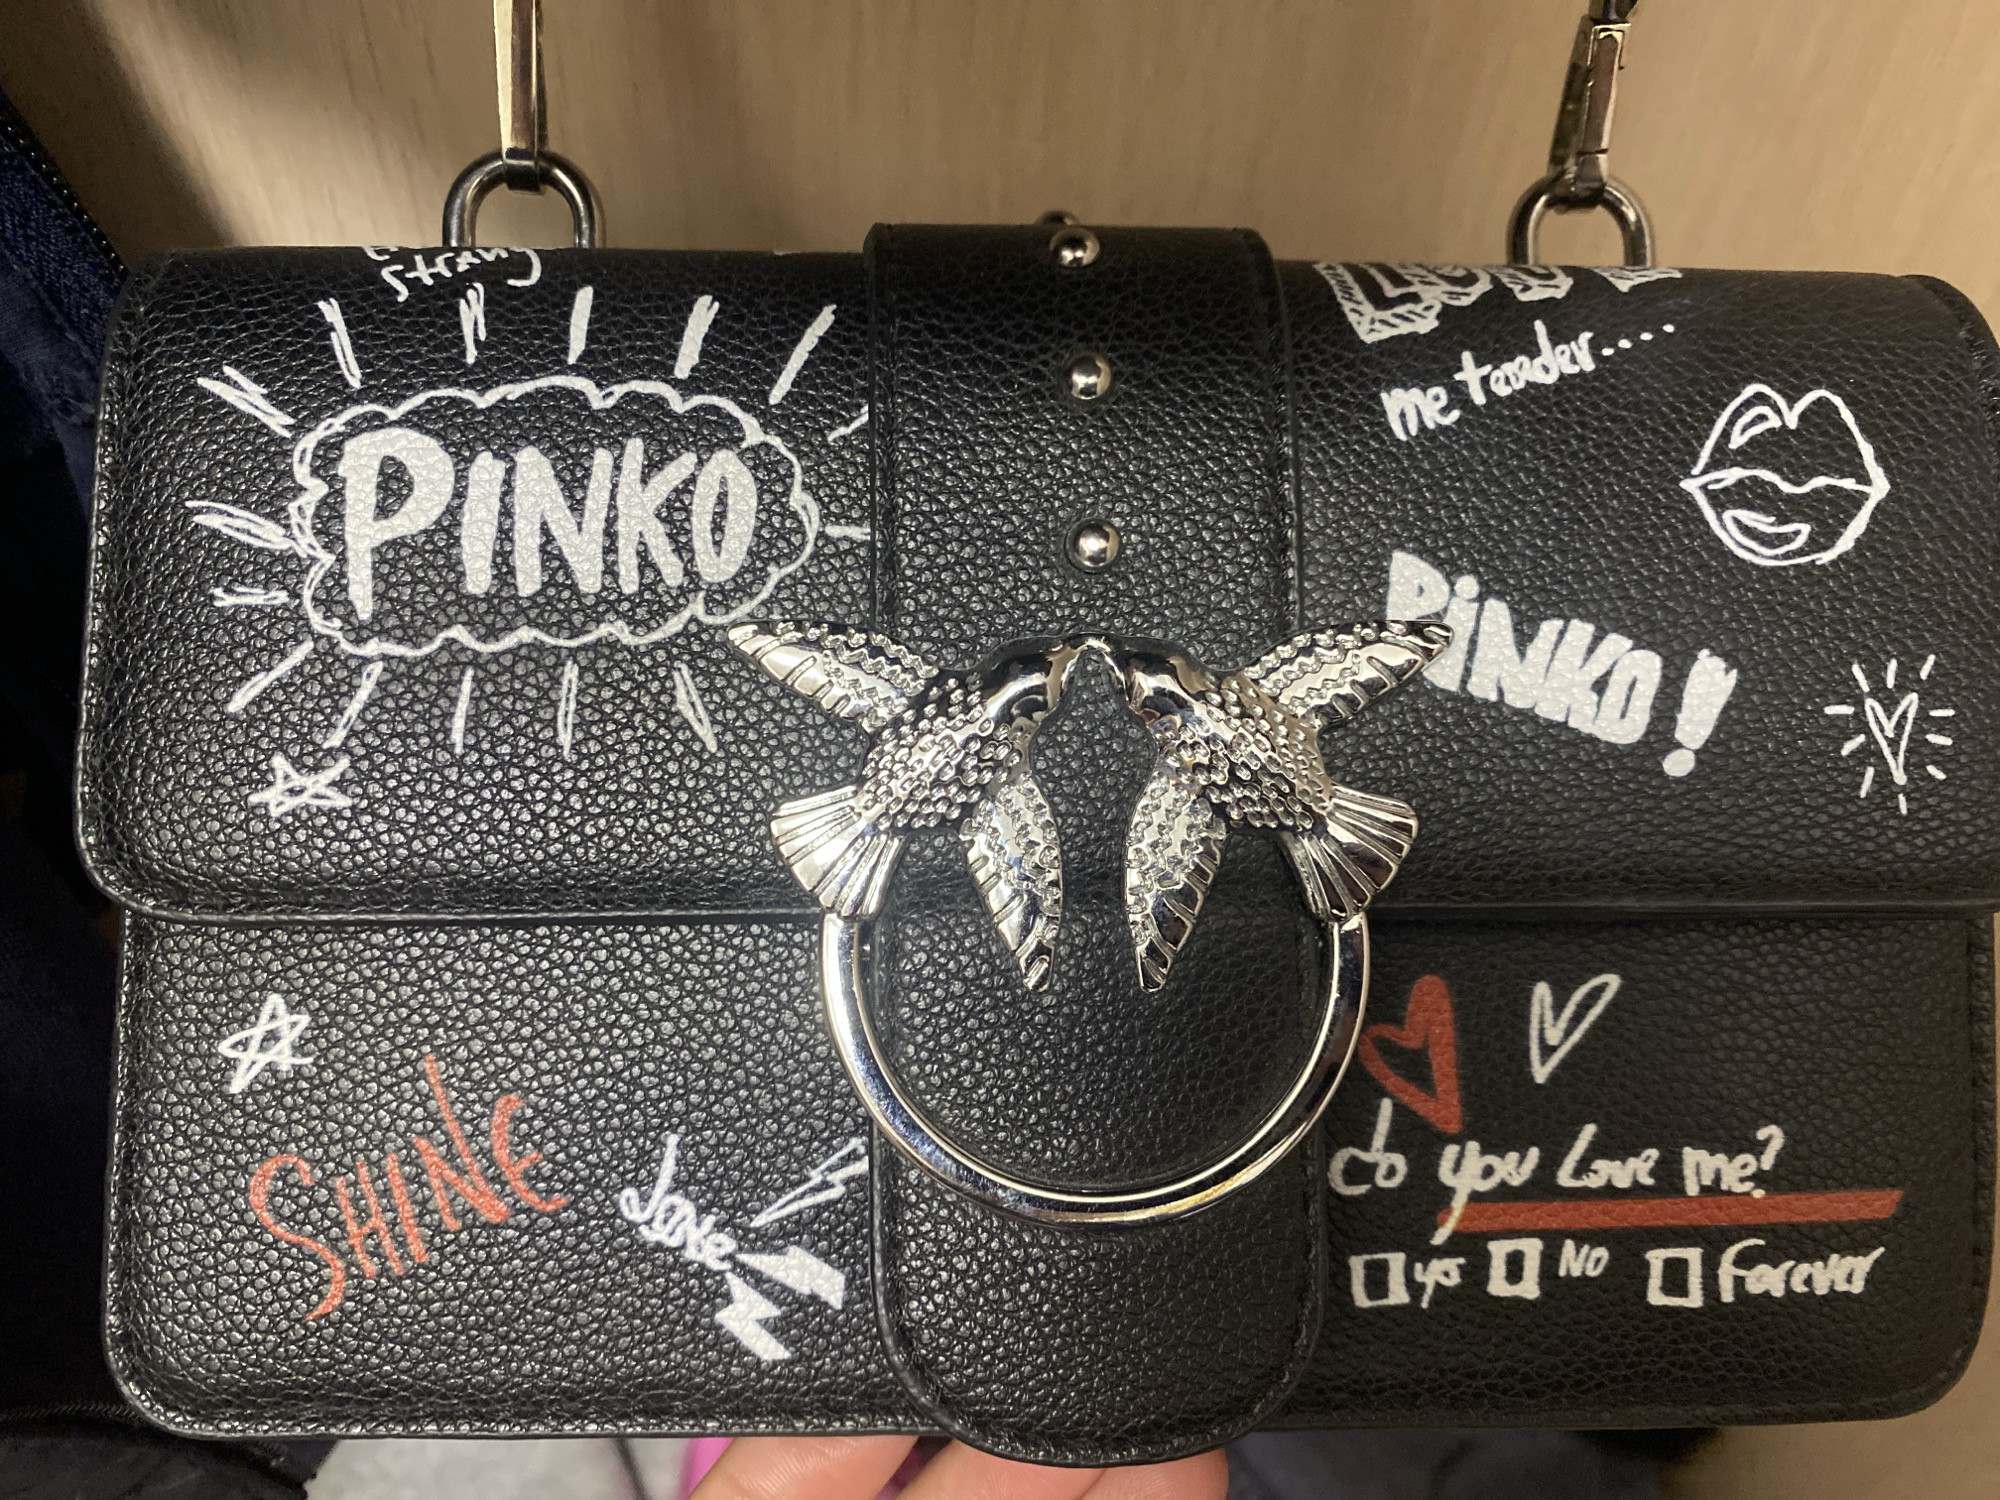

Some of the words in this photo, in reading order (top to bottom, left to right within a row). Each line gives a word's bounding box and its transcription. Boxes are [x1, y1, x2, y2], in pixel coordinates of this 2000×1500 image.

[1380, 386, 1461, 442] me
[338, 427, 758, 621] PINKO
[249, 1053, 568, 1320] SHINE
[1430, 1141, 1540, 1245] you
[1682, 1125, 1785, 1199] me?
